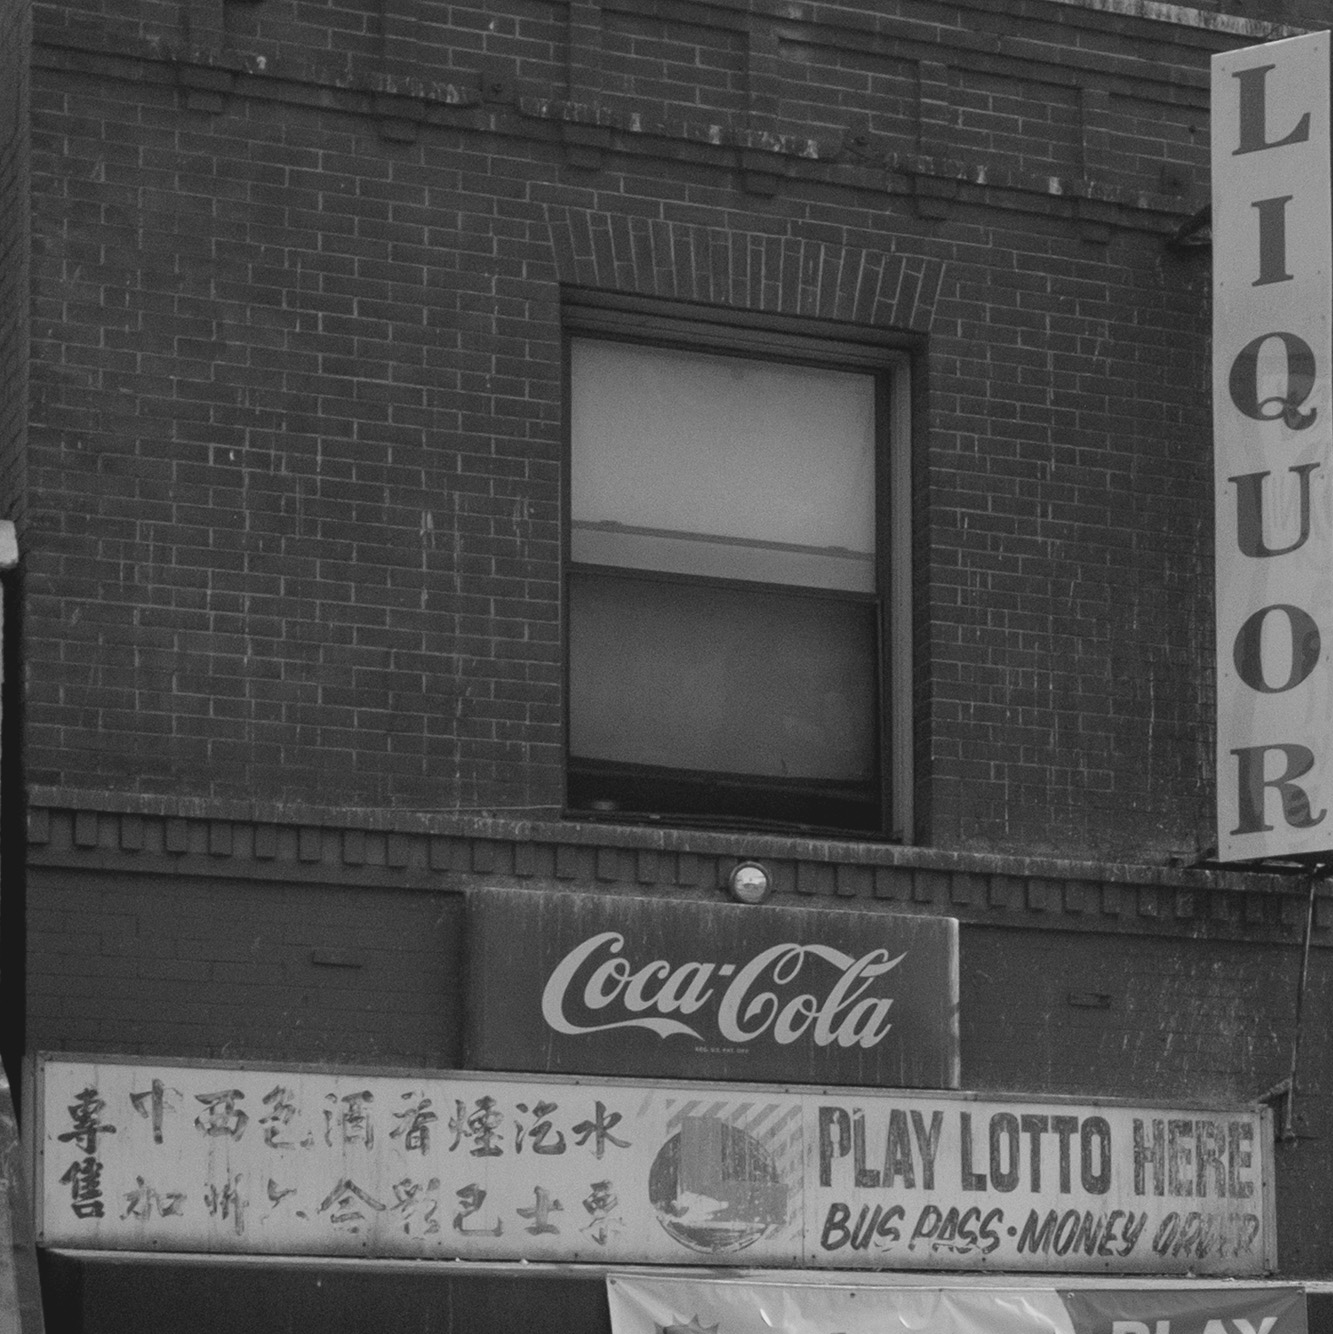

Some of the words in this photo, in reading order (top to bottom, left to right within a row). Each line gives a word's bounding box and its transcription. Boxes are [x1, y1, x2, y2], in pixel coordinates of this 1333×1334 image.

[1228, 63, 1328, 837] LIQUOR
[541, 931, 909, 1049] Coca-Cola
[818, 1106, 944, 1191] PLAY
[960, 1110, 1112, 1195] LOTTO
[1133, 1117, 1255, 1199] HERE
[820, 1203, 905, 1252] BUS
[911, 1204, 1004, 1254] PASS
[1017, 1207, 1148, 1257] MONEY
